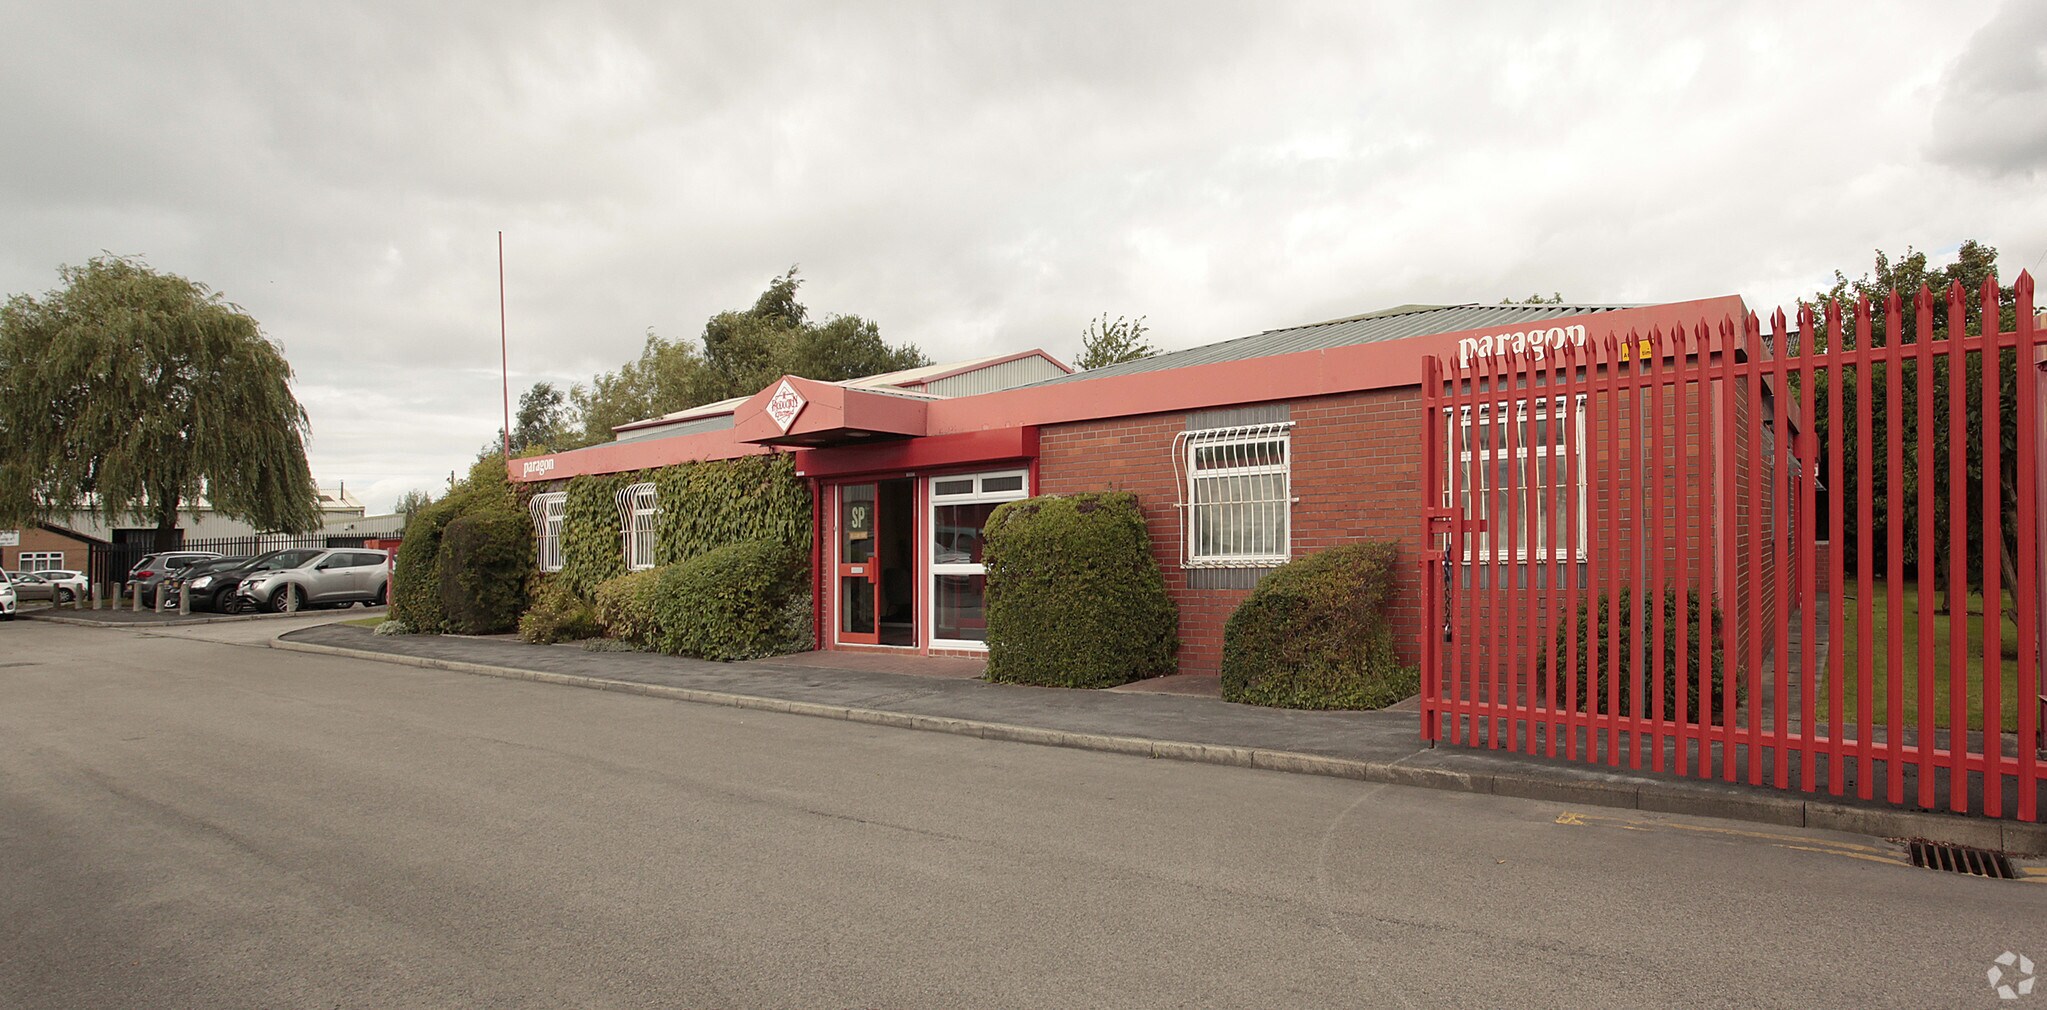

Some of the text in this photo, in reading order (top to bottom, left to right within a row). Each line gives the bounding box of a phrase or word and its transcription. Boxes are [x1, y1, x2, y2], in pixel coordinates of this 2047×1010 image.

[1458, 324, 1586, 369] paragon
[523, 458, 554, 478] paragon
[852, 506, 865, 528] SP
